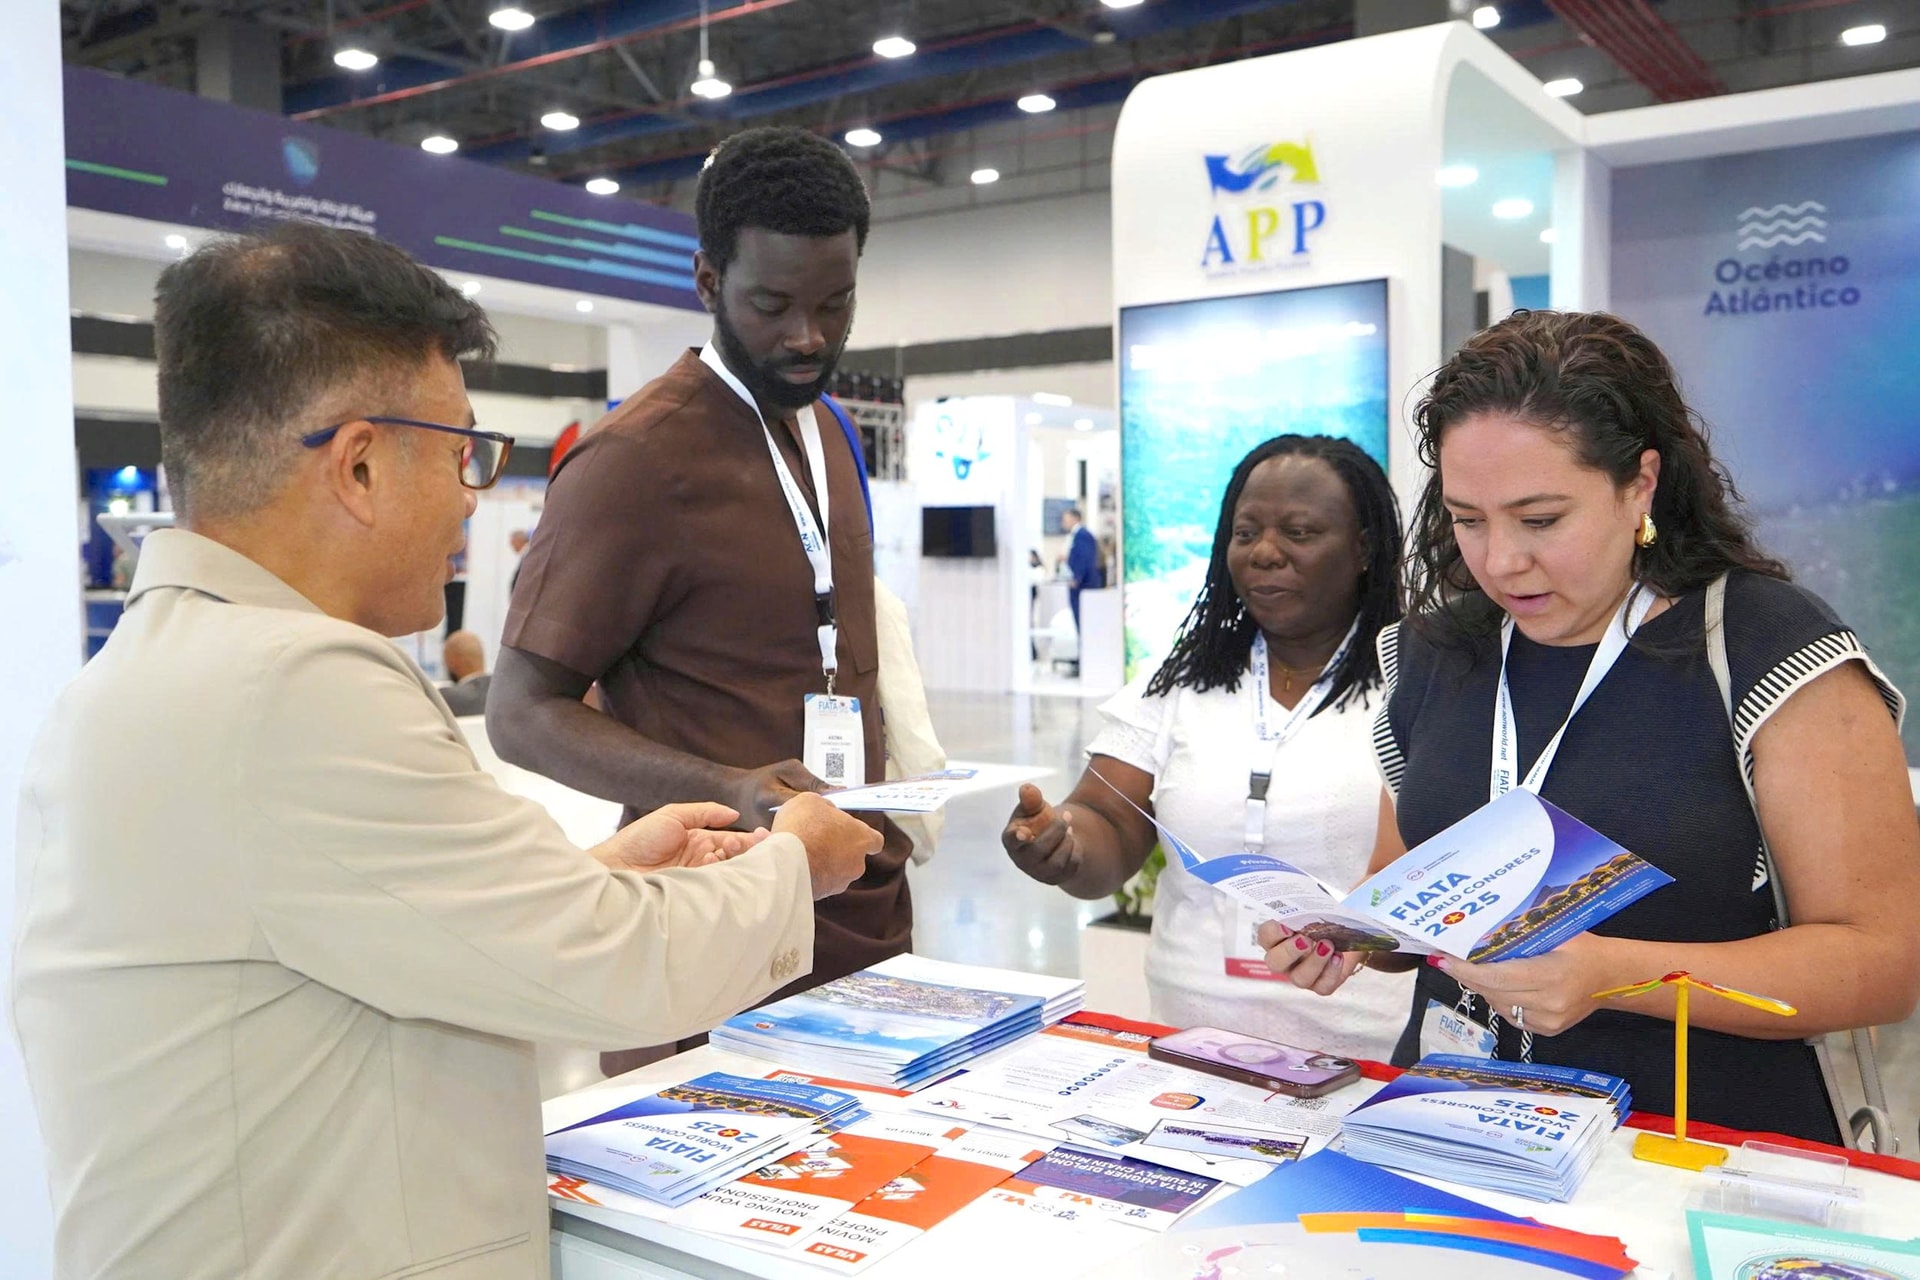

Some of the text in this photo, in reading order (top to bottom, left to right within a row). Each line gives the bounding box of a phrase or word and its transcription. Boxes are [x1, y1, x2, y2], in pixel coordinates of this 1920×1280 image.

[1202, 200, 1326, 267] APP
[1715, 254, 1849, 285] Océano
[1704, 283, 1861, 316] Atlántico
[818, 701, 838, 710] FIATA
[1389, 872, 1472, 921] FIATA
[1409, 893, 1462, 927] WORLD
[1463, 847, 1541, 894] CONGRESS
[1440, 1015, 1463, 1036] FIATA
[1421, 1097, 1571, 1130] WORLD CONGRESS
[1478, 1113, 1566, 1142] FIATA
[622, 1120, 733, 1152] WORLD CONGRESS
[645, 1137, 717, 1163] FIATA
[1045, 1156, 1201, 1196] FIATA HIGHER DIPLOMA
[1103, 1160, 1140, 1175] CHAIN
[1135, 1169, 1189, 1187] SUPPLY
[1188, 1181, 1209, 1190] IN
[749, 1219, 792, 1234] VILAS
[814, 1245, 857, 1261] VILAS
